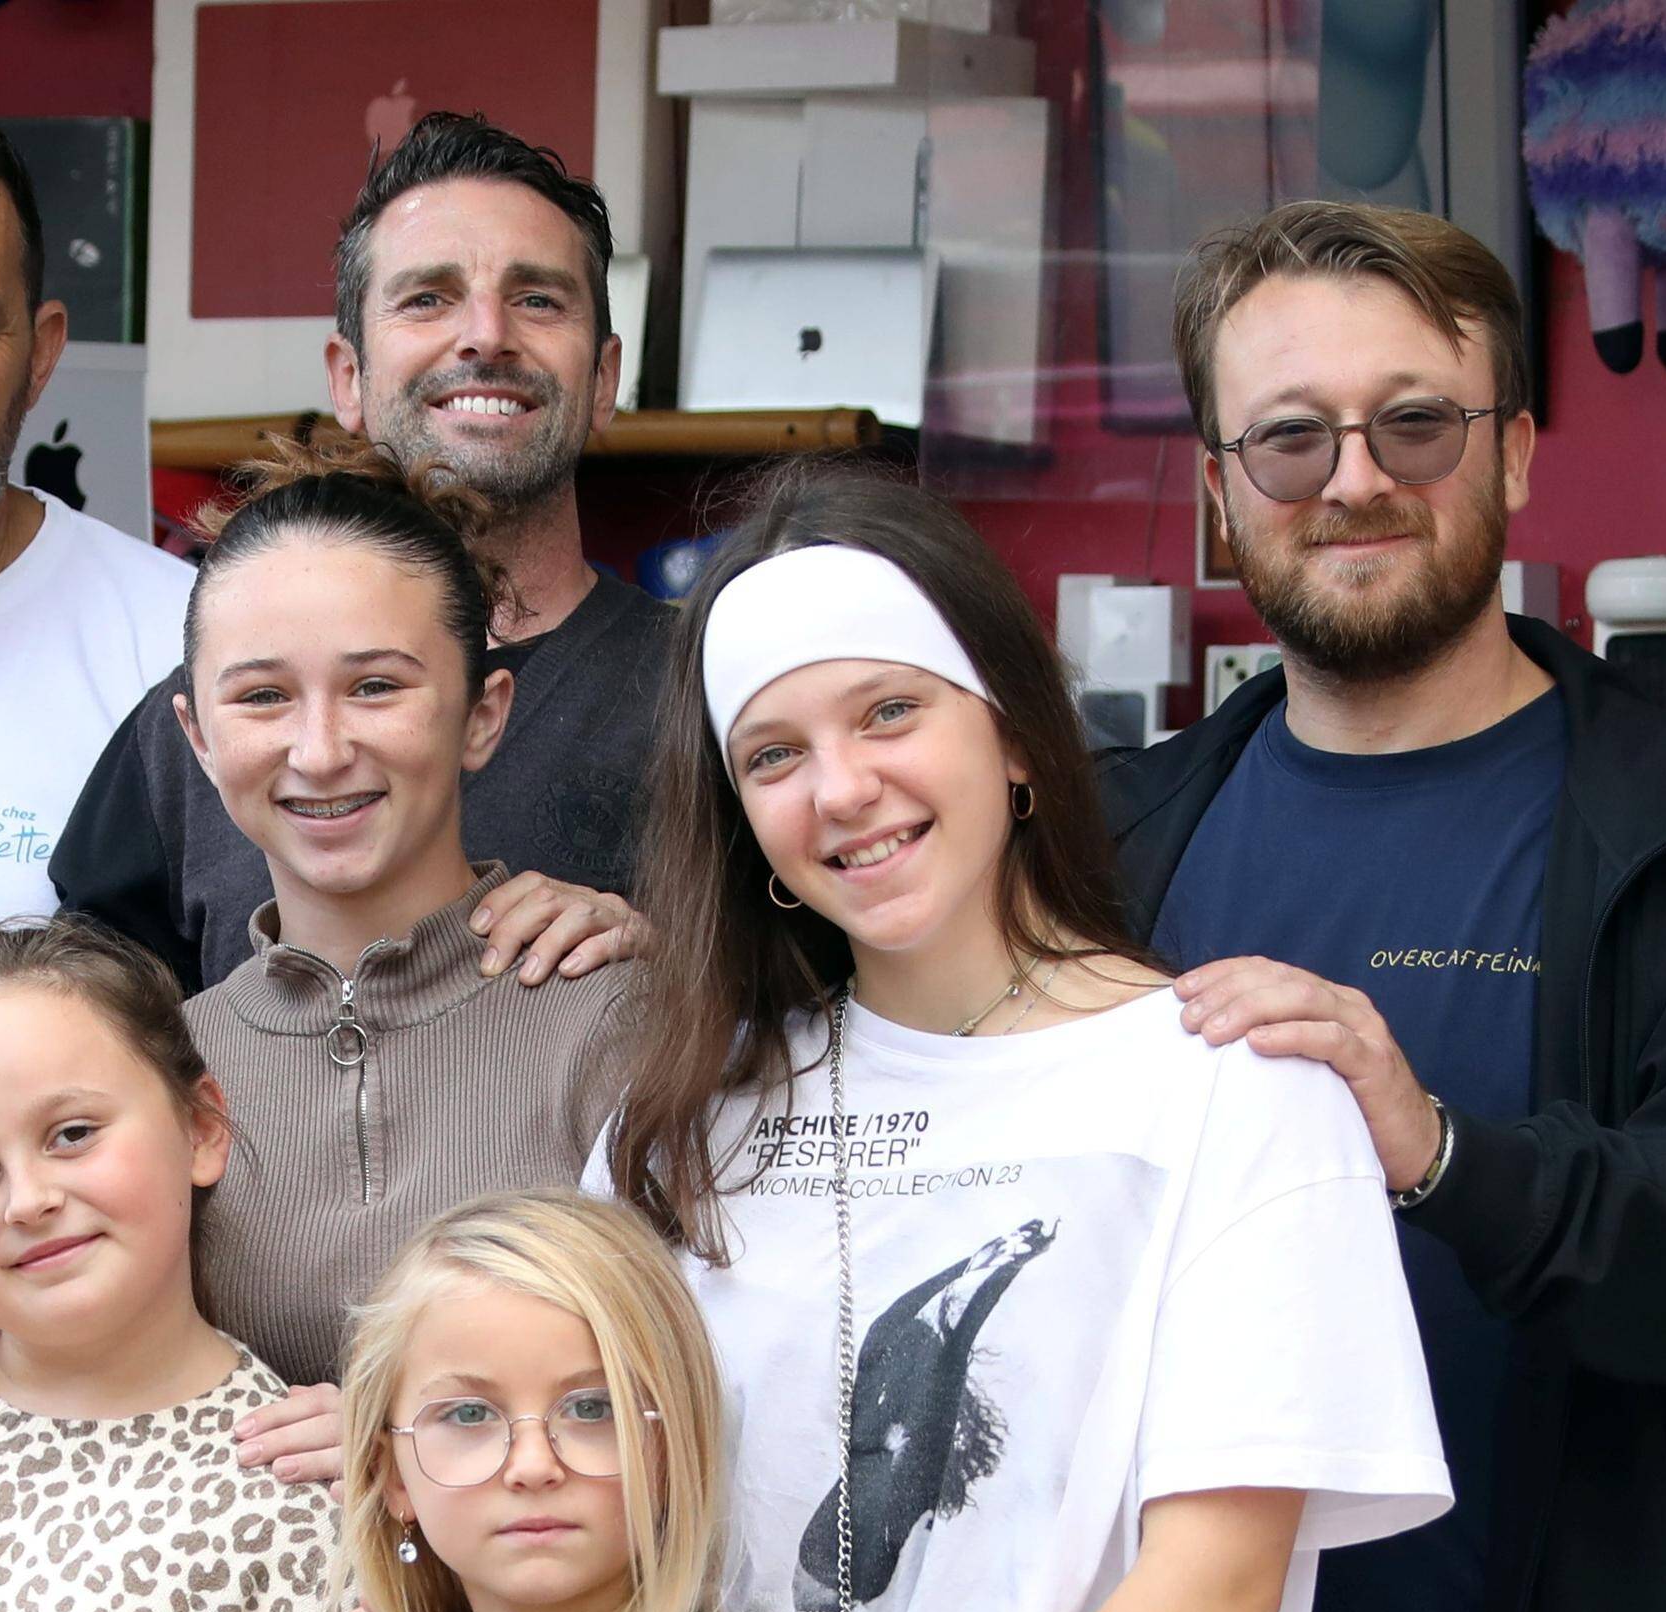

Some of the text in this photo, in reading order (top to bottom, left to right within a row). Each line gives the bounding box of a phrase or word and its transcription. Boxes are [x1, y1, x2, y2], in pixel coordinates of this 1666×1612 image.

[2, 806, 37, 821] chez
[1370, 947, 1540, 976] OVERCAFFEINA
[862, 1111, 930, 1136] /1970
[849, 1167, 994, 1199] COLLECTION
[996, 1164, 1023, 1185] 23
